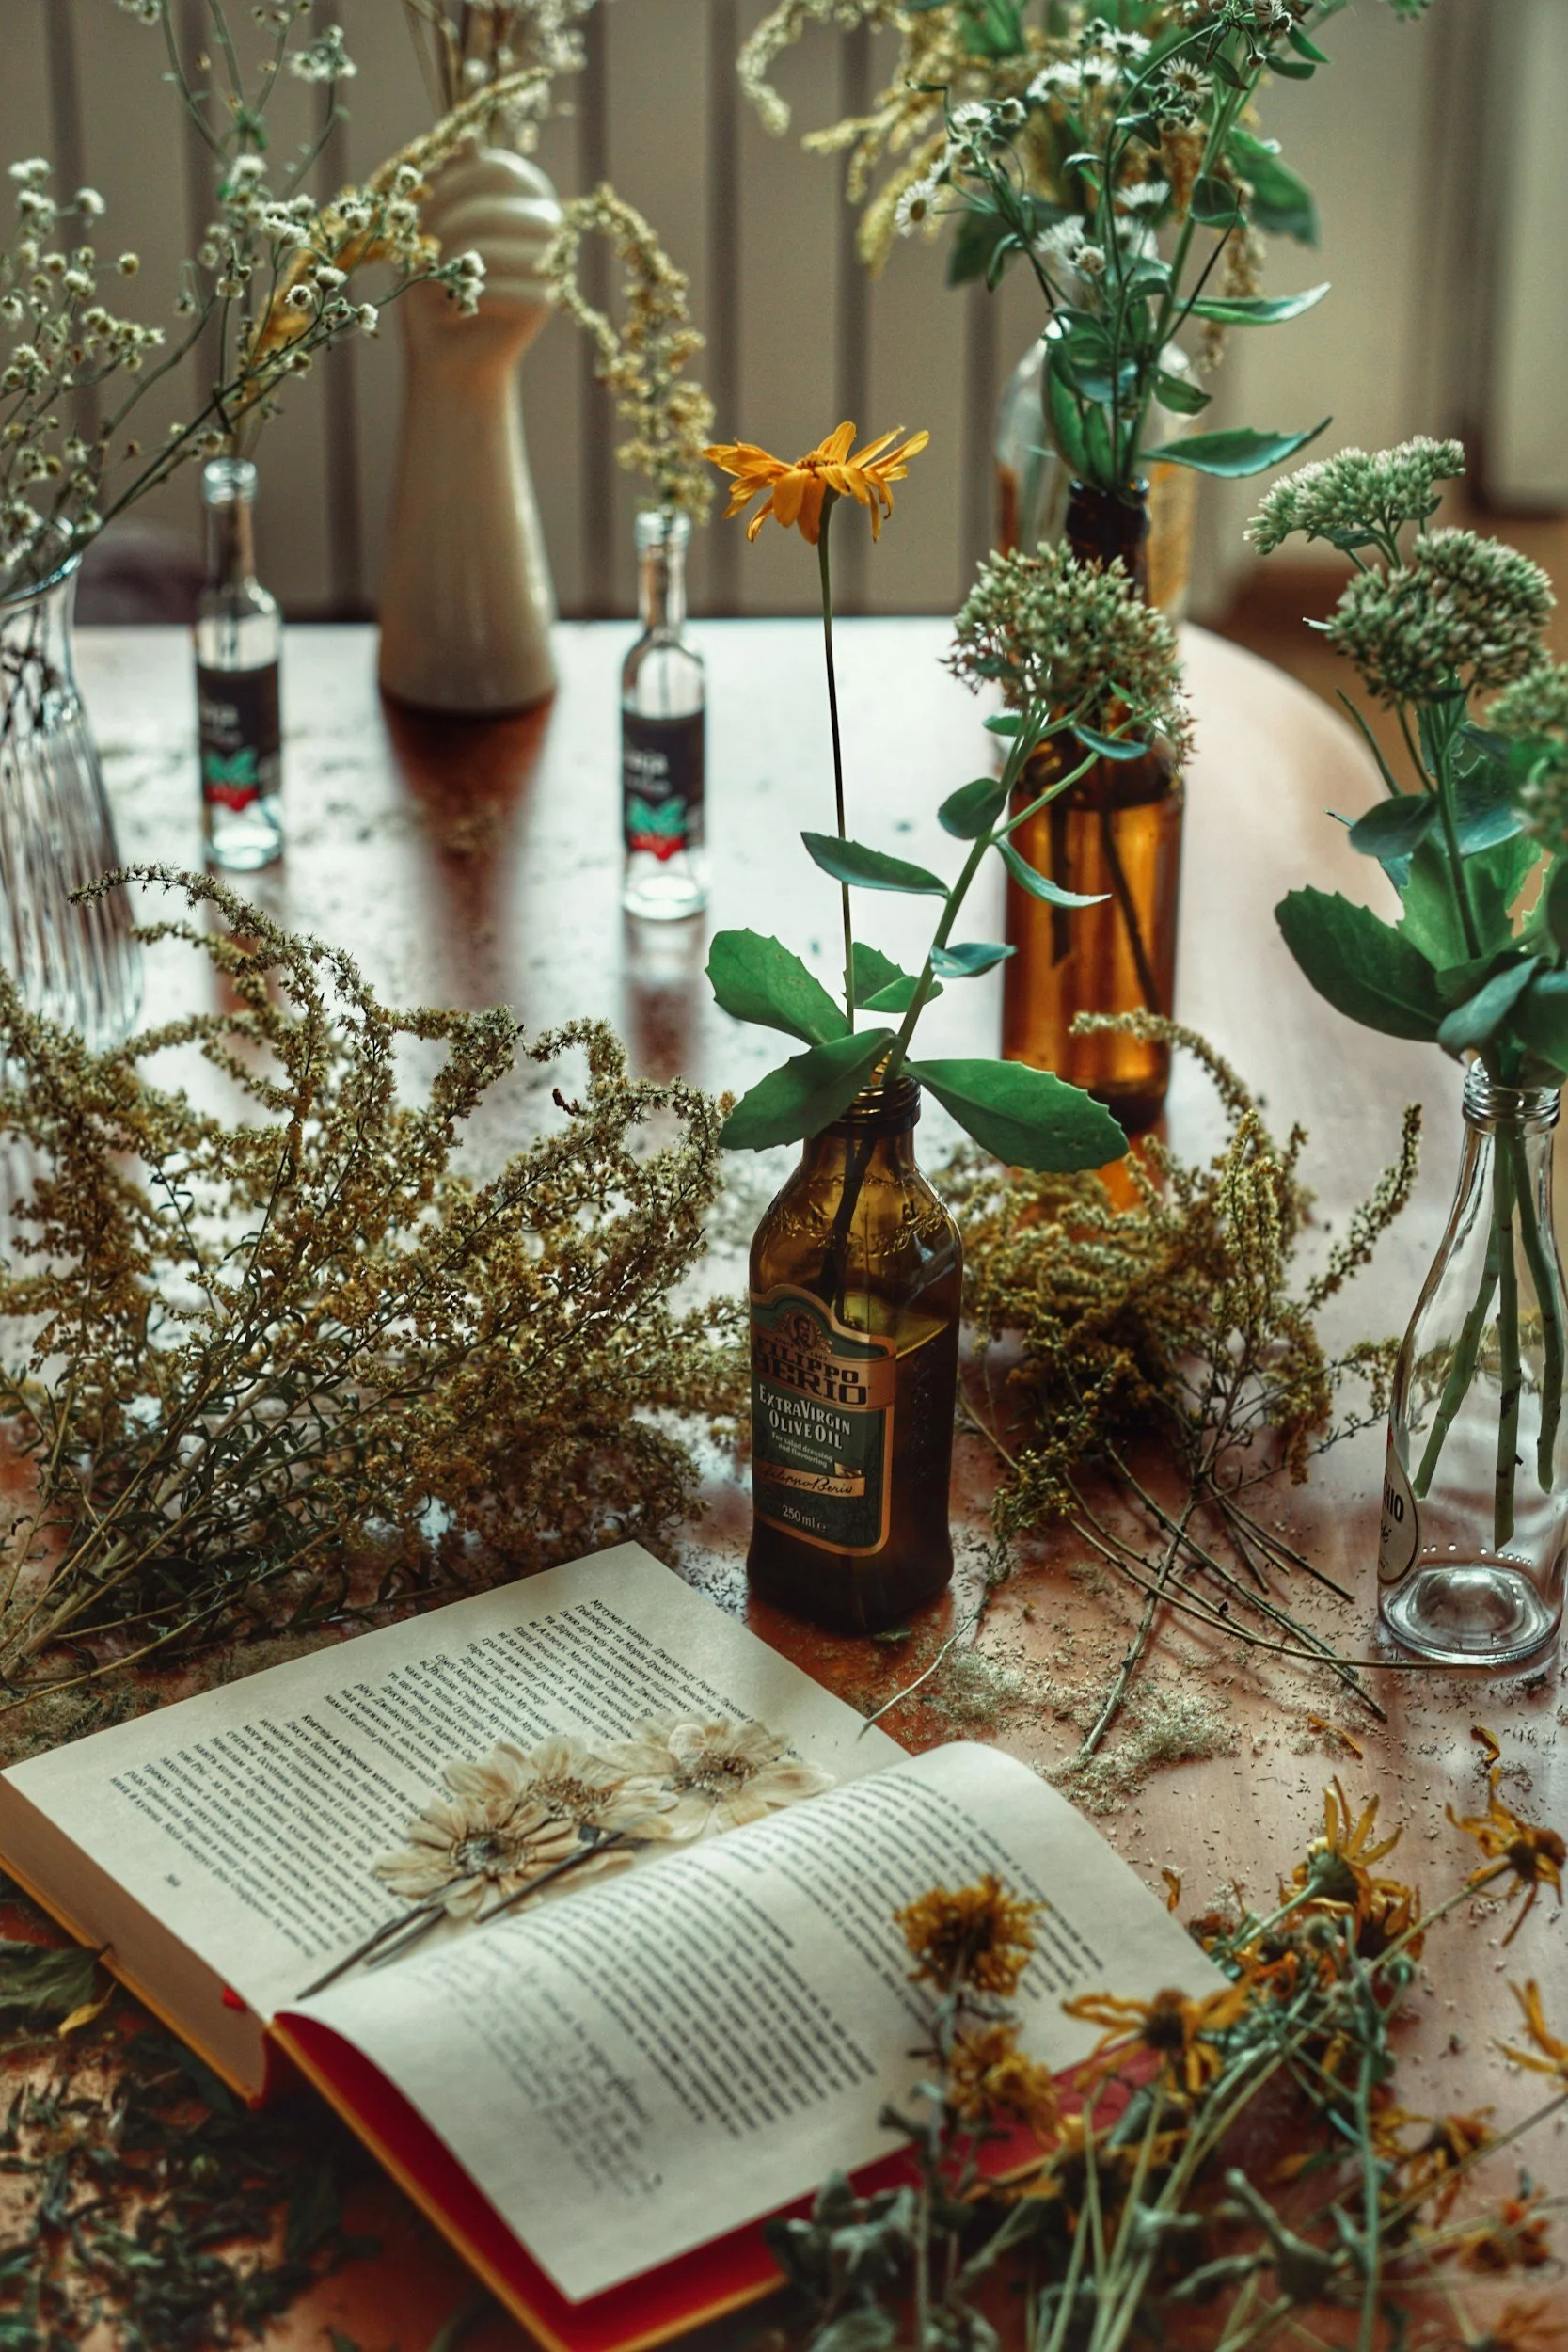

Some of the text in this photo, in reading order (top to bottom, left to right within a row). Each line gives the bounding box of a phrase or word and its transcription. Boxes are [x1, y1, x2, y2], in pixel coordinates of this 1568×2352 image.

[755, 1351, 867, 1406] BERIO
[757, 1336, 859, 1384] FILIPPO
[758, 1383, 851, 1436] EXTRA VIRGIN
[769, 1410, 843, 1450] OLIVE OIL
[771, 1431, 833, 1463] For salad dressing
[778, 1443, 828, 1470] and flavouring
[783, 1504, 801, 1522] 250
[512, 1625, 536, 1643] Ешлі
[565, 1667, 598, 1691] Кассові
[566, 1650, 608, 1680] Майклові
[576, 1625, 609, 1647] дружбу
[615, 1654, 653, 1682] незмінну
[622, 1641, 647, 1661] Морін
[339, 1689, 356, 1703] над
[481, 1637, 507, 1656] грали
[504, 1655, 540, 1681] важливу
[534, 1680, 557, 1696] роль
[566, 1704, 594, 1724] моєму
[515, 1645, 536, 1661] їхню
[573, 1691, 597, 1710] також
[379, 1685, 408, 1706] Дякую
[405, 1704, 434, 1725] Пітеру
[409, 1689, 430, 1705] вона
[428, 1703, 456, 1726] чудова
[453, 1724, 481, 1746] сестра
[259, 1718, 294, 1747] незмінну
[283, 1720, 312, 1742] Дякую
[323, 1694, 341, 1708] нам
[345, 1712, 377, 1738] Кейтлін
[372, 1737, 416, 1771] розповісти
[301, 1714, 332, 1740] Кейтлін
[371, 1772, 397, 1794] хотіла
